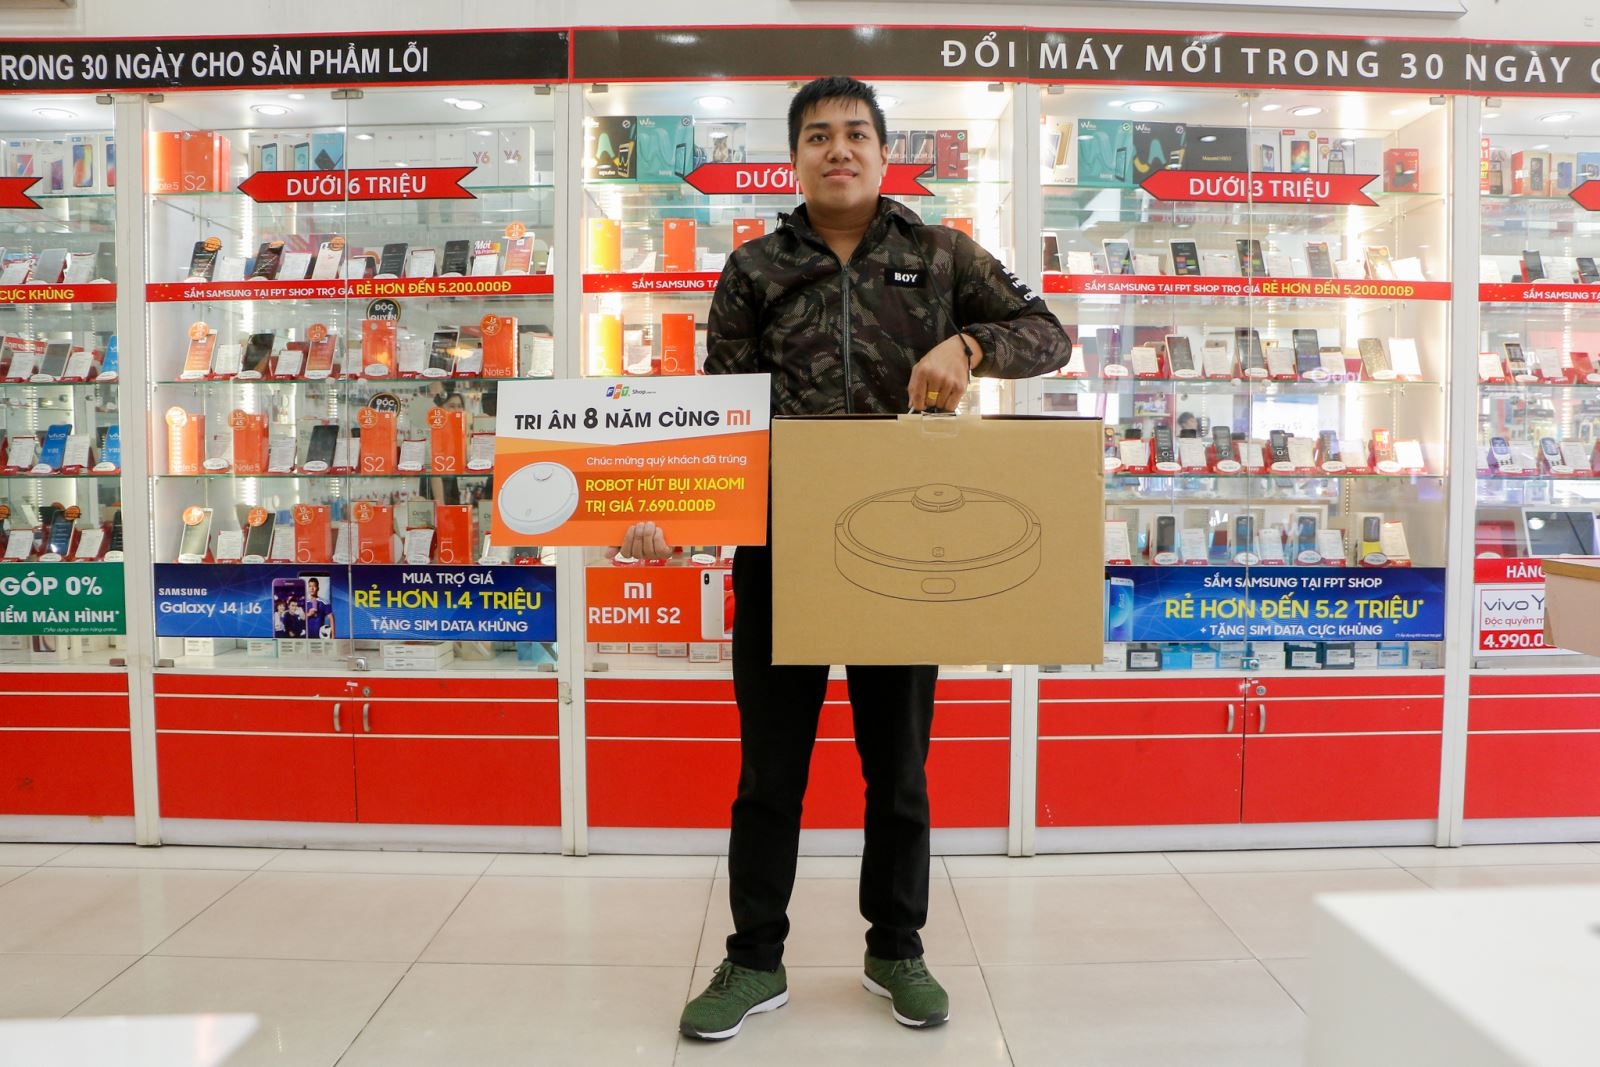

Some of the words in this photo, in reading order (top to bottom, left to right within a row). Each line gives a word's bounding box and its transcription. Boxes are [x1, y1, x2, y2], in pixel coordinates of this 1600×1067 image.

[82, 54, 108, 80] 30
[116, 47, 186, 79] NGÀY
[191, 52, 244, 78] CHO
[252, 45, 302, 77] SẢN
[310, 43, 380, 75] PHẨM
[388, 41, 429, 74] LỖI
[940, 31, 1016, 68] ĐỔI
[1040, 38, 1124, 70] MÁY
[1145, 40, 1221, 73] MỚI
[1240, 47, 1379, 78] TRONG
[1400, 53, 1444, 80] 30
[1466, 52, 1571, 83] NGÀY
[184, 175, 206, 191] S2
[286, 174, 342, 196] DƯỚI
[348, 178, 360, 194] 6
[366, 172, 426, 198] TRIỆU
[736, 168, 794, 189] DƯỚI
[1189, 174, 1246, 196] DƯỚI
[1252, 179, 1264, 196] 3
[1270, 177, 1330, 202] TRIỆU
[632, 278, 654, 289] SẮM
[656, 280, 704, 288] SAMSUNG
[894, 272, 918, 282] BOY
[29, 287, 74, 300] KHỦNG
[184, 287, 204, 298] SẮM
[206, 289, 252, 298] SAMSUNG
[253, 288, 268, 300] TẠI
[270, 288, 287, 297] FPT
[288, 288, 314, 296] SHOP
[316, 287, 336, 298] TRỢ
[356, 281, 372, 294] RẺ
[376, 282, 404, 294] HƠN
[408, 279, 435, 294] ĐẾN
[438, 281, 512, 294] 5.200.000Đ
[1084, 280, 1106, 291] SẮM
[1108, 282, 1155, 292] SAMSUNG
[1158, 283, 1173, 294] TẠI
[1174, 283, 1192, 292] FPT
[1194, 284, 1220, 293] SHOP
[1222, 284, 1242, 296] TRỢ
[1243, 283, 1260, 294] GIÁ
[1262, 280, 1278, 294] RẺ
[1282, 282, 1311, 294] HƠN
[1314, 280, 1340, 294] ĐẾN
[1343, 284, 1414, 296] 5.200.000Đ
[1522, 288, 1543, 300] SẮM
[1544, 291, 1589, 300] SAMSUNG
[374, 304, 394, 313] ĐỘC
[664, 350, 678, 372] 5
[606, 384, 630, 400] FPT
[514, 414, 542, 430] TRI
[548, 410, 576, 430] ÂN
[583, 407, 598, 429] 8
[606, 408, 652, 429] NĂM
[658, 406, 720, 428] CÙNG
[364, 456, 384, 472] S2
[434, 456, 456, 472] S2
[586, 455, 613, 466] Chúc
[614, 455, 644, 468] mừng
[646, 455, 666, 468] quý
[668, 454, 700, 465] khách
[702, 454, 716, 464] đã
[718, 454, 748, 466] trúng
[585, 478, 634, 492] ROBOT
[637, 476, 666, 491] HÚT
[668, 478, 690, 494] BỤI
[694, 477, 745, 491] XIAOMI
[585, 500, 606, 516] TRỊ
[609, 496, 634, 512] GIÁ
[638, 499, 716, 512] 7.690.000Đ
[297, 541, 311, 564] 5
[360, 542, 374, 563] 5
[440, 541, 454, 564] 5
[0, 571, 58, 596] GÓP
[66, 576, 103, 596] 0%
[402, 572, 434, 584] MUA
[436, 572, 465, 588] TRỢ
[468, 571, 494, 584] GIÁ
[1204, 572, 1232, 588] SẮM
[1234, 577, 1298, 588] SAMSUNG
[1300, 578, 1320, 591] TẠI
[1324, 578, 1346, 588] FPT
[1348, 577, 1382, 588] SHOP
[158, 588, 208, 596] SAMSUNG
[354, 584, 381, 608] RẺ
[387, 588, 438, 609] HƠN
[445, 590, 472, 608] 1.4
[479, 587, 542, 616] TRIỆU
[160, 601, 216, 618] Galaxy
[1165, 592, 1194, 618] RẺ
[1200, 597, 1256, 618] HƠN
[1260, 592, 1309, 618] ĐẾN
[1315, 600, 1348, 619] 5.2
[1484, 598, 1530, 611] vivo
[32, 608, 70, 623] MÀN
[588, 607, 650, 624] REDMI
[656, 607, 681, 624] S2
[1484, 616, 1503, 626] Độc
[1505, 615, 1534, 626] quyền
[371, 616, 411, 634] TẶNG
[414, 620, 438, 632] SIM
[441, 620, 475, 632] DATA
[478, 618, 528, 632] KHỦNG
[1210, 622, 1245, 638] TẶNG
[1250, 625, 1272, 636] SIM
[1274, 624, 1304, 636] DATA
[1308, 624, 1336, 638] CỰC
[1338, 622, 1383, 636] KHỦNG
